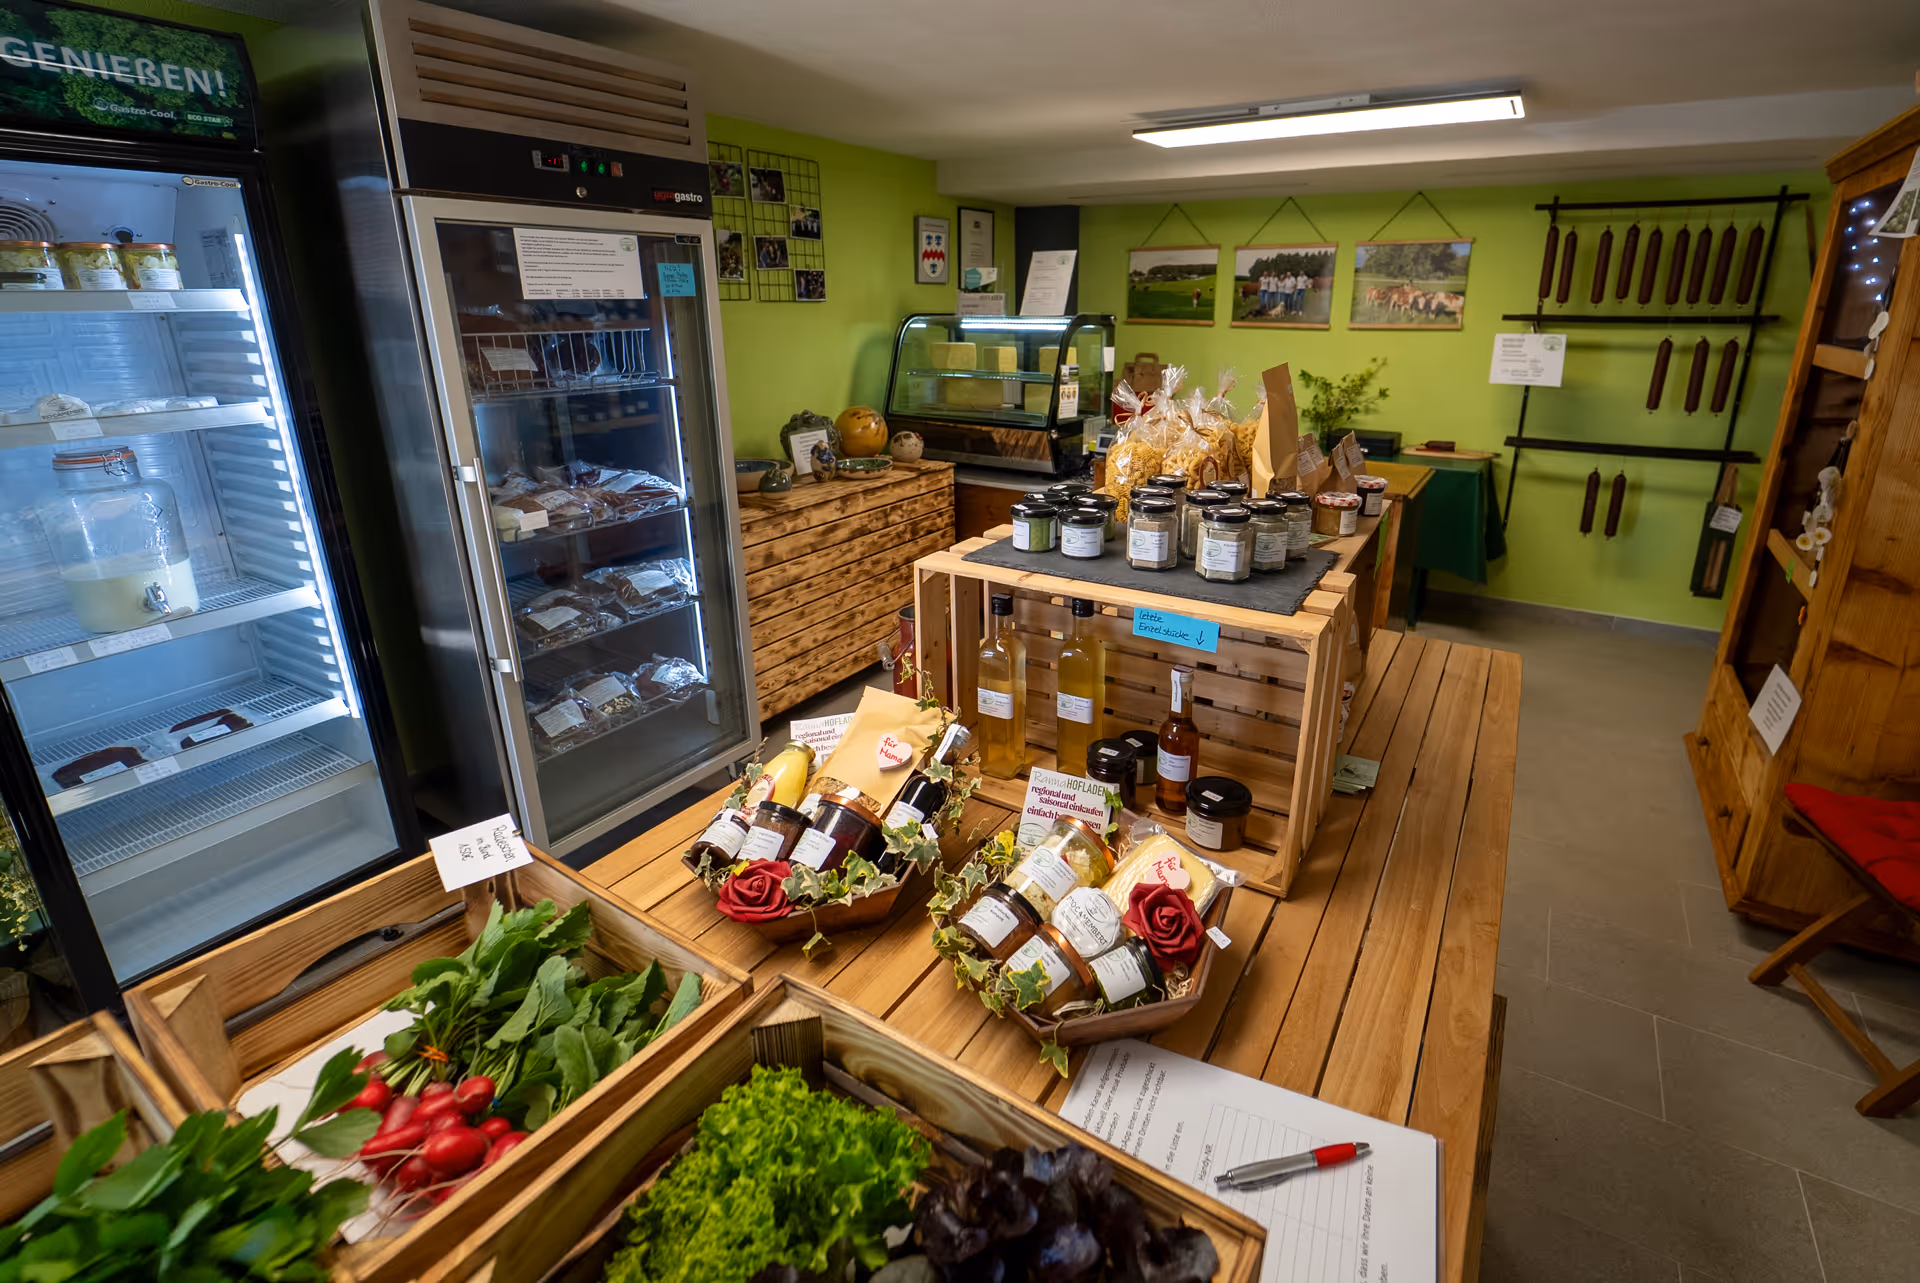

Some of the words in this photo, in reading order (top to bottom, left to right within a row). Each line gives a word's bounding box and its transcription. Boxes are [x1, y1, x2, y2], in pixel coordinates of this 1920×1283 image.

[883, 737, 898, 748] für
[880, 747, 903, 764] Mama
[1031, 785, 1061, 799] regional
[1061, 792, 1076, 802] und
[1027, 805, 1056, 820] einfach
[1039, 795, 1068, 808] saisonal
[1069, 803, 1104, 817] einkaufen
[1127, 1110, 1138, 1130] einen
[1133, 1096, 1143, 1111] Link
[1139, 1061, 1156, 1097] zugeschickt
[1139, 1112, 1152, 1136] Dritten
[1147, 1095, 1158, 1113] nicht
[1153, 1069, 1167, 1097] sichtbar.
[1082, 1089, 1102, 1132] unden-Kanal
[1094, 1110, 1108, 1134] aktuell
[1102, 1093, 1112, 1111] über
[1110, 1078, 1120, 1096] neue
[1105, 1111, 1121, 1143] werden?
[1176, 1120, 1185, 1134] ein.
[1169, 1133, 1181, 1151] Liste
[1165, 1150, 1175, 1163] die
[1365, 1164, 1374, 1185] keine
[1366, 1185, 1373, 1197] an
[1362, 1198, 1372, 1222] Daten
[1360, 1241, 1369, 1256] wir
[1358, 1257, 1369, 1279] dass
